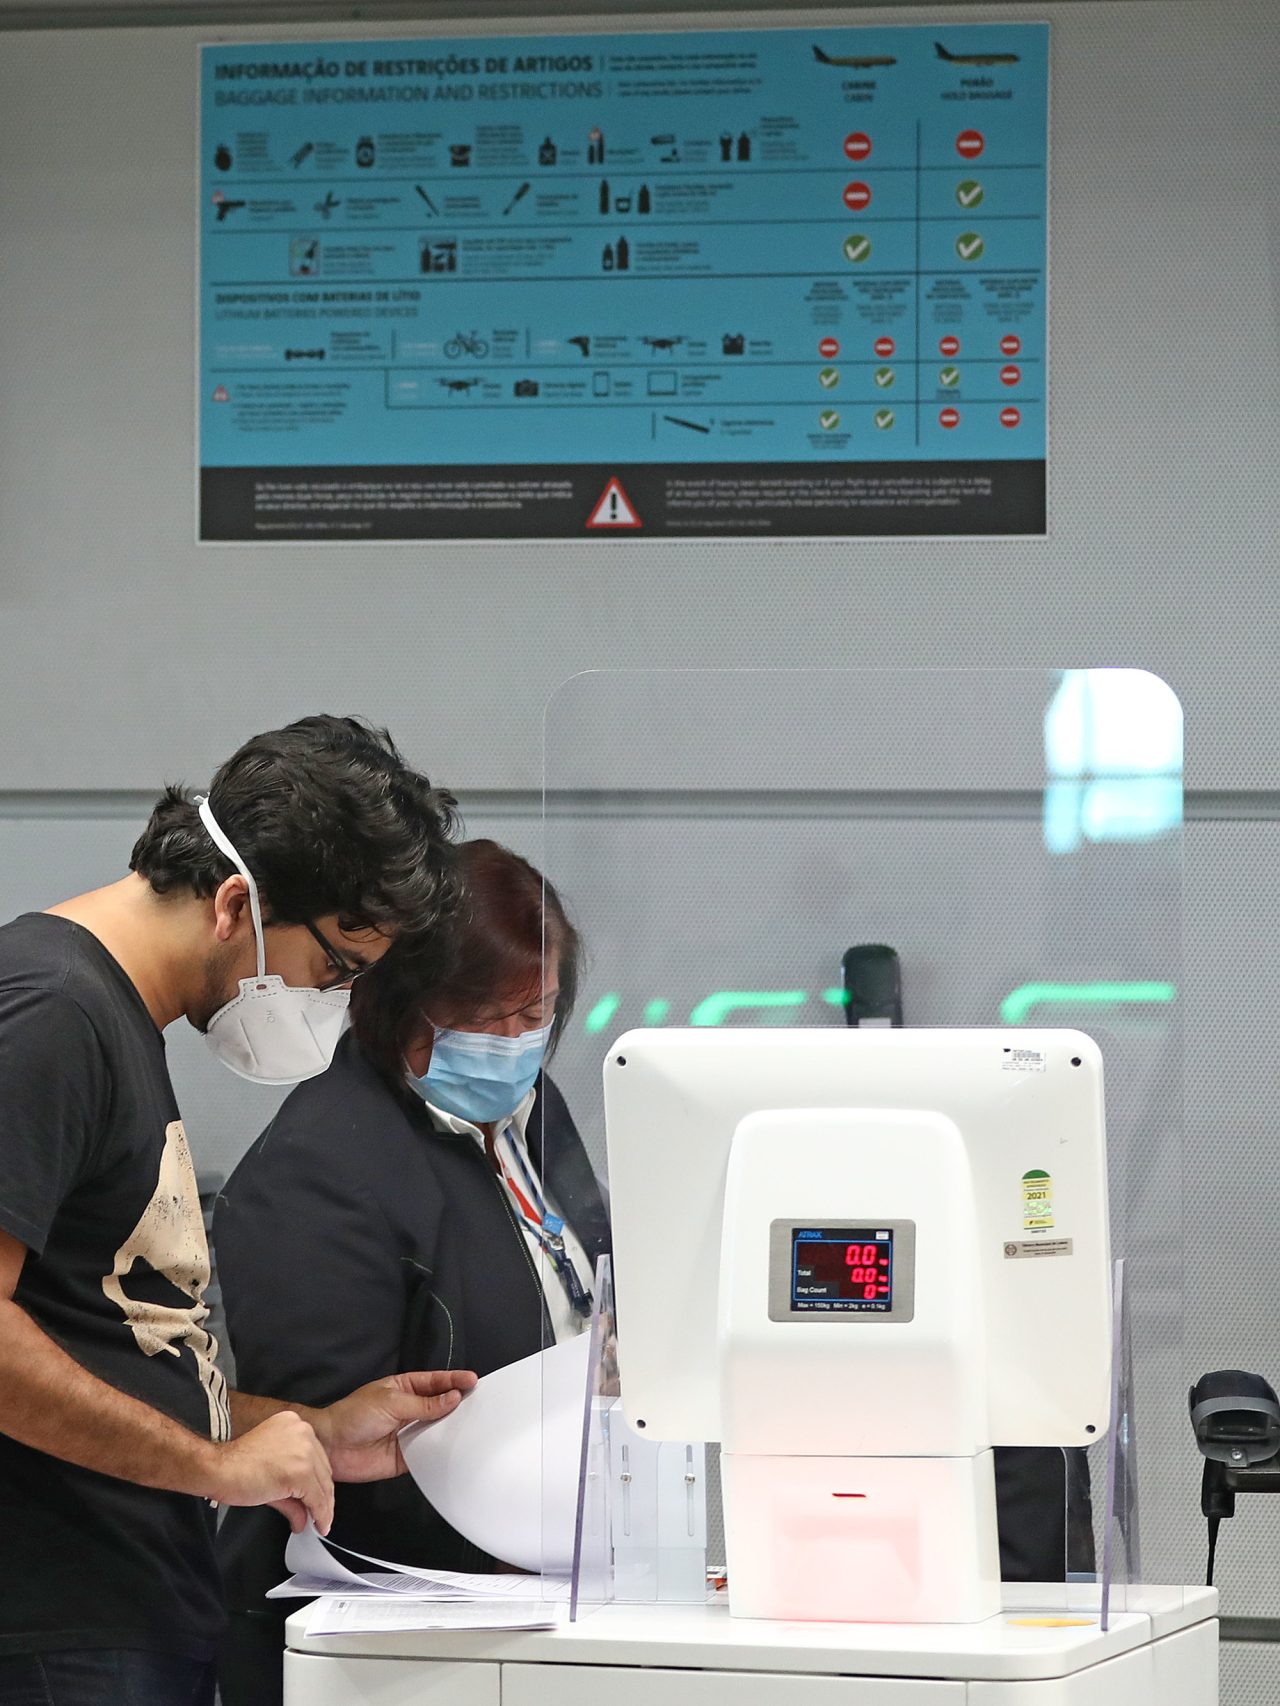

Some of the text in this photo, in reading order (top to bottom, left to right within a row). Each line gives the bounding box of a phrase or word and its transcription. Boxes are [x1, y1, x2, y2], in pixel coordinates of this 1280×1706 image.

[215, 56, 340, 82] INFORMAÇÃO
[345, 59, 367, 78] DE
[373, 55, 480, 80] RESTRIÇÕES
[485, 57, 508, 75] DE
[513, 56, 593, 74] ARTIGOS
[215, 89, 296, 107] BAGGAGE
[303, 85, 429, 105] INFORMATION
[433, 84, 473, 102] AND
[478, 80, 602, 99] RESTRICTIONS
[1026, 1192, 1046, 1200] 2021
[797, 1269, 811, 1277] Total
[797, 1287, 809, 1295] Bag
[810, 1286, 827, 1294] Count
